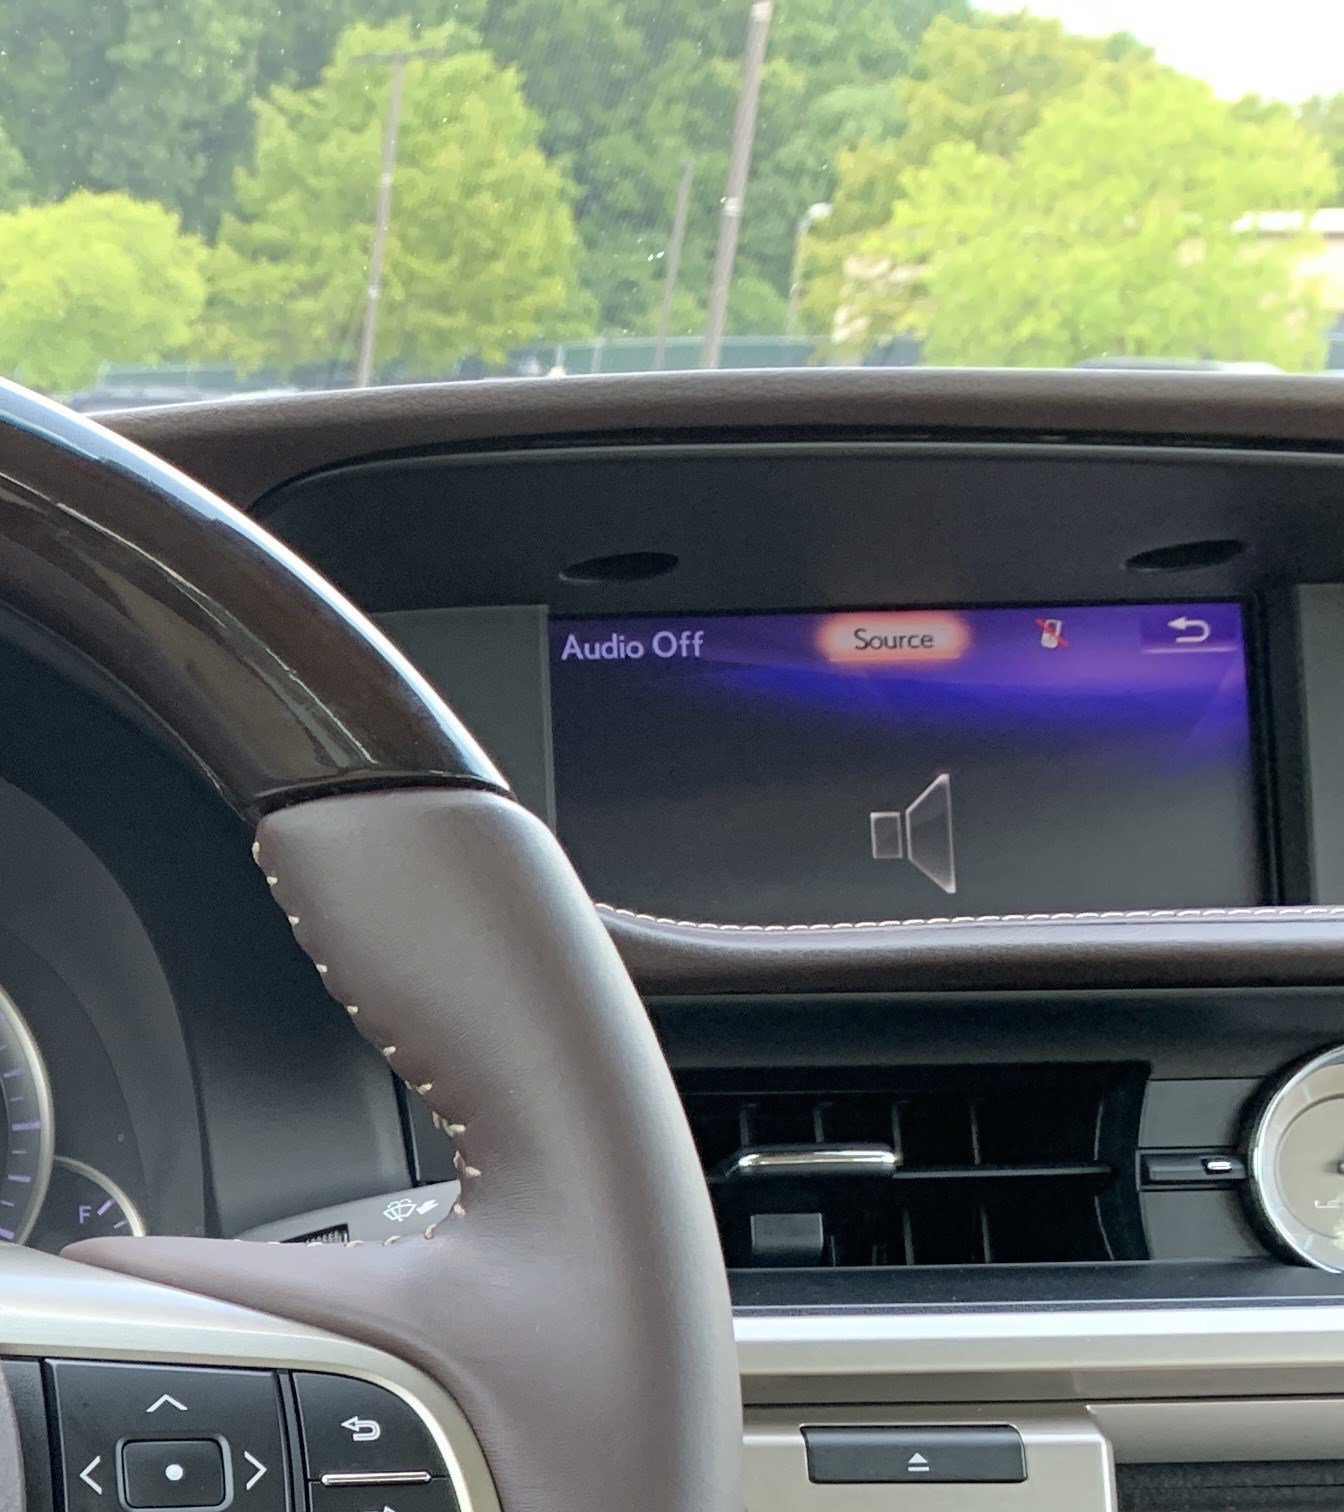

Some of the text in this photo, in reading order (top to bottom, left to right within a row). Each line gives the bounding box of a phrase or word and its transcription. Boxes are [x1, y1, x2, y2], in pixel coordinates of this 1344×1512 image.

[561, 629, 705, 661] Audio Off
[853, 627, 935, 651] Source
[78, 1205, 92, 1224] F
